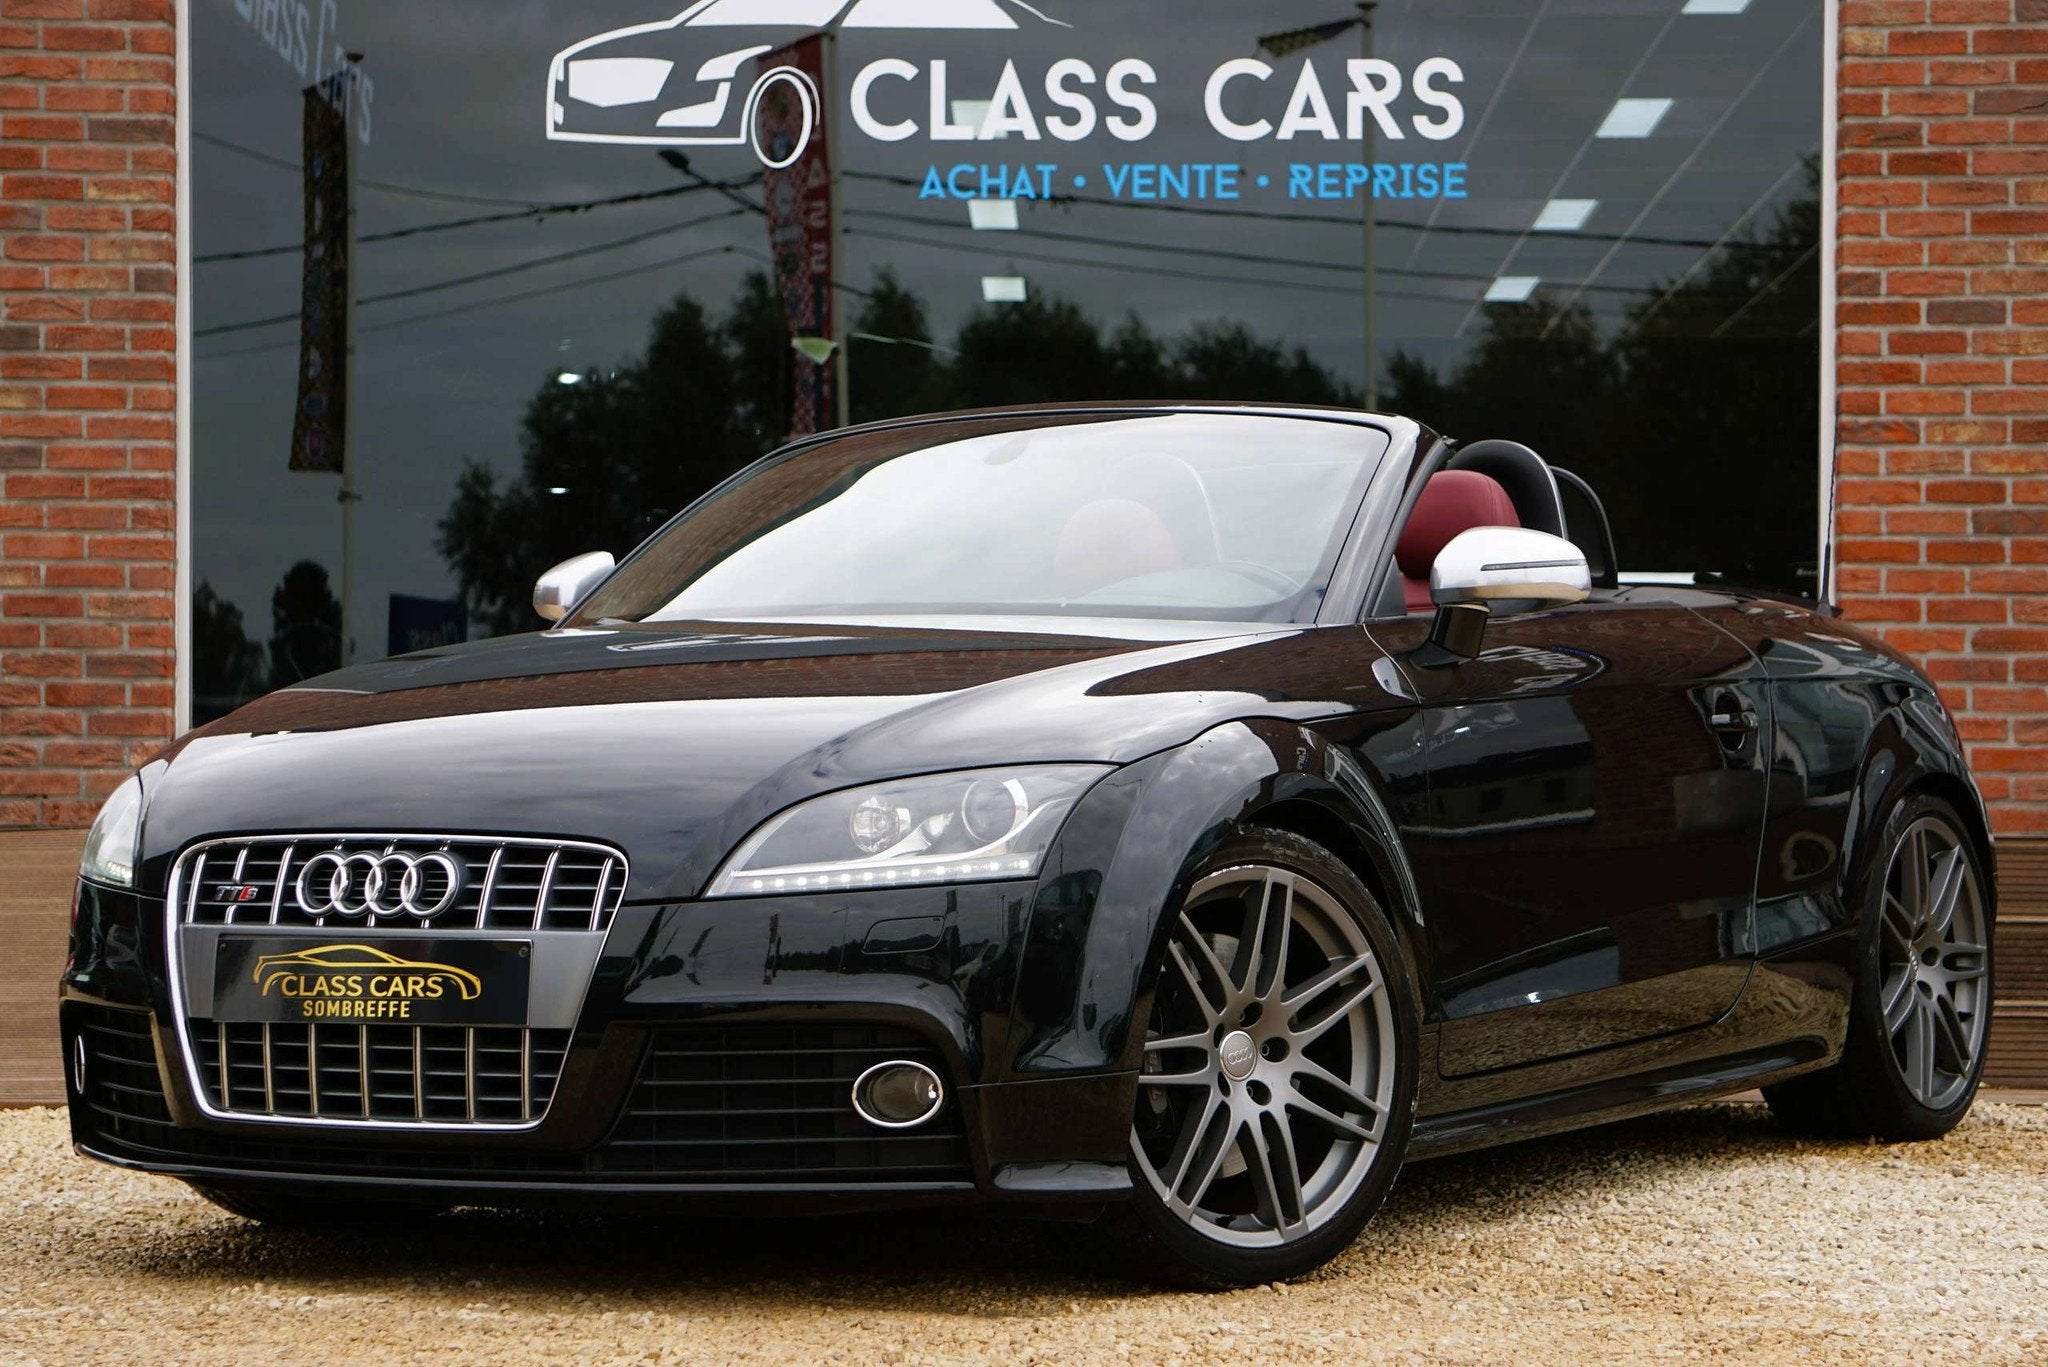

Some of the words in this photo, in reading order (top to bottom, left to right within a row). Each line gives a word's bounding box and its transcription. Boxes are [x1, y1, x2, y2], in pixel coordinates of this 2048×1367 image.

[233, 0, 311, 78] ass
[851, 58, 1157, 141] CLASS
[1204, 57, 1464, 141] CARS
[919, 163, 1058, 200] ACHAT
[1103, 163, 1240, 200] VENTE
[1288, 162, 1469, 200] REPRISE
[213, 885, 259, 901] TTS
[281, 975, 364, 998] CLASS
[369, 975, 444, 998] CARS
[302, 1000, 411, 1018] SOMBREFFE
